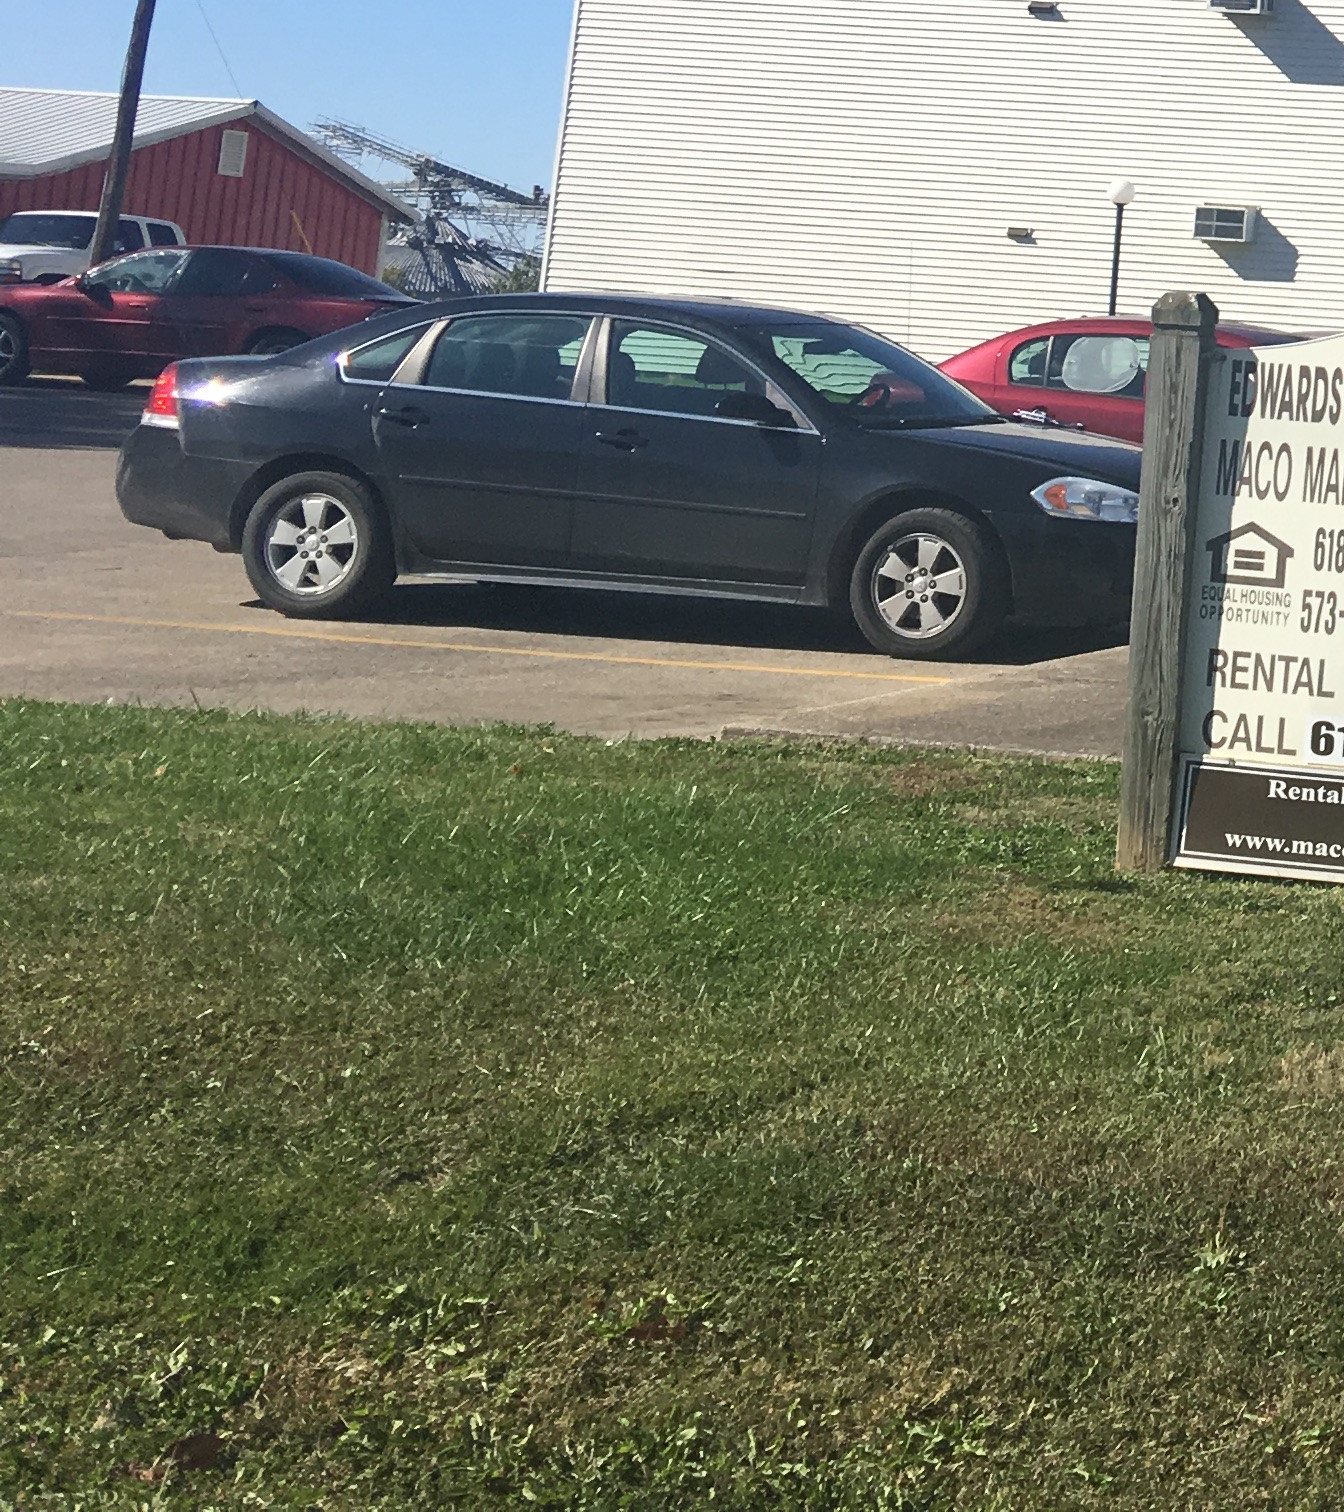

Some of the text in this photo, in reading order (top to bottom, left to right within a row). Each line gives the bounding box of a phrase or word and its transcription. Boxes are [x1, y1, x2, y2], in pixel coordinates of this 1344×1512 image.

[1228, 359, 1343, 426] EDWARDS
[1215, 439, 1293, 502] MACO
[1199, 604, 1291, 628] OPPORTUNITY
[1201, 585, 1292, 609] EQUAL HOUSING
[1206, 648, 1335, 699] RENTAL
[1202, 709, 1297, 757] CALL
